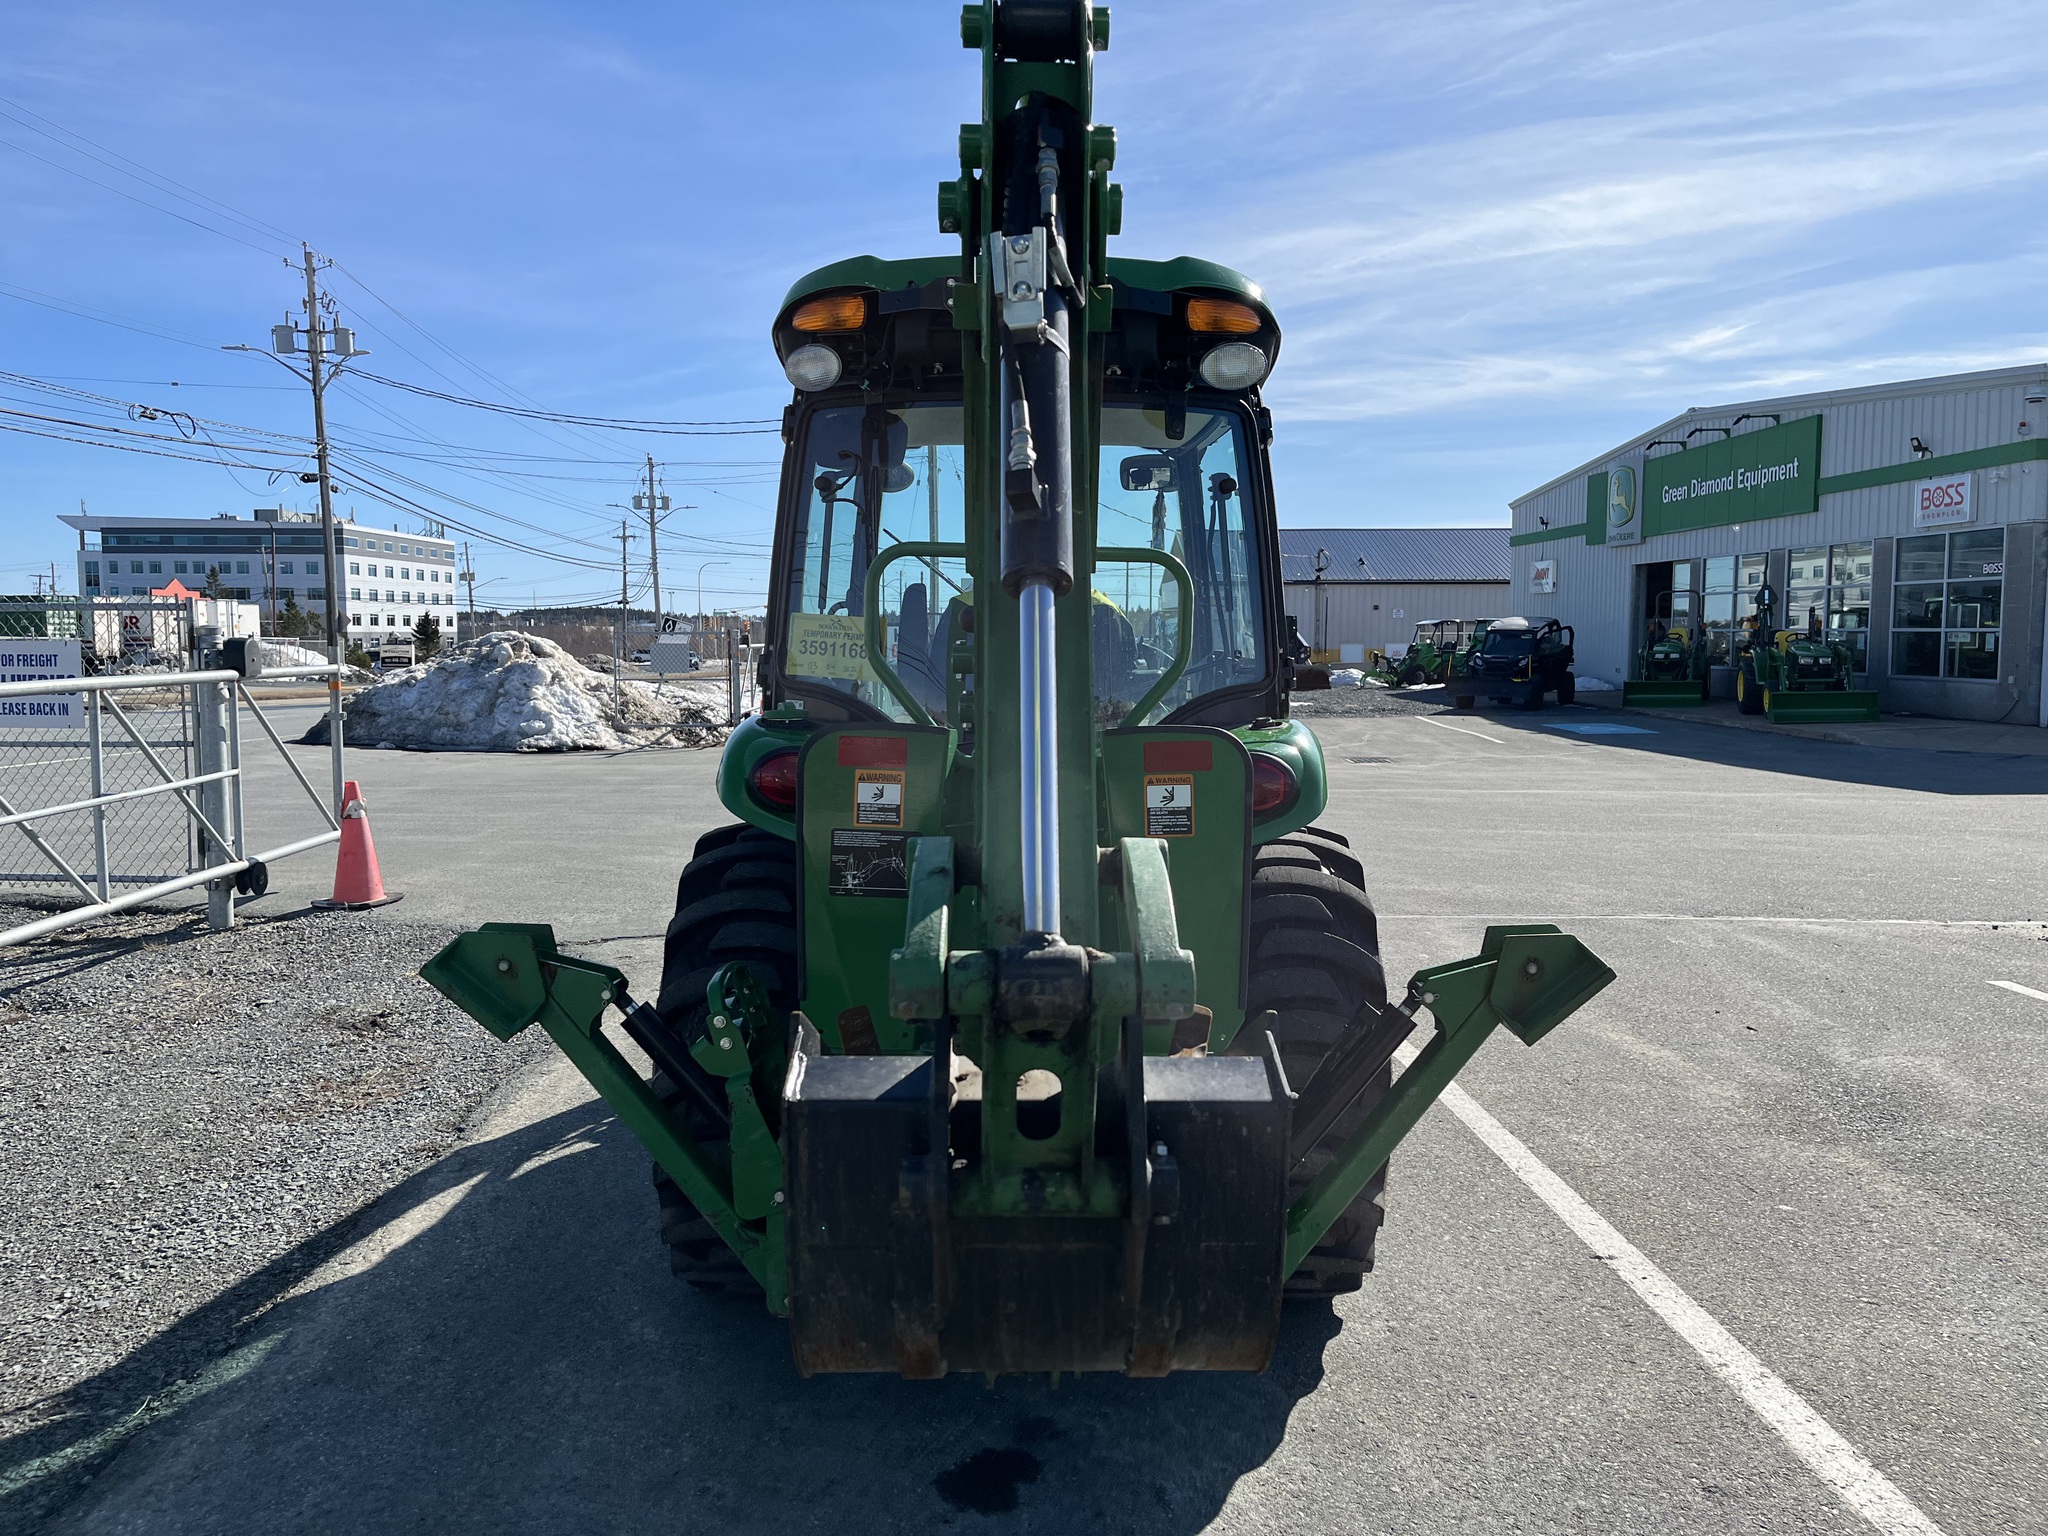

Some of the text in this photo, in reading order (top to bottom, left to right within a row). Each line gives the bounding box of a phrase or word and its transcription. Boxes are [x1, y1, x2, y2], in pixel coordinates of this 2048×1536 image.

[1662, 457, 1799, 504] Green Diamond Equipment
[1920, 482, 1965, 511] BOSS
[1616, 532, 1635, 542] DEERE
[1983, 563, 2003, 573] BOSS
[803, 630, 842, 640] TEMPORARY
[799, 639, 868, 659] 3591168
[16, 653, 58, 668] FREIGHT
[29, 702, 56, 716] BACK
[58, 702, 69, 716] IN
[866, 773, 902, 783] WARNING
[1155, 776, 1191, 784] WARNING
